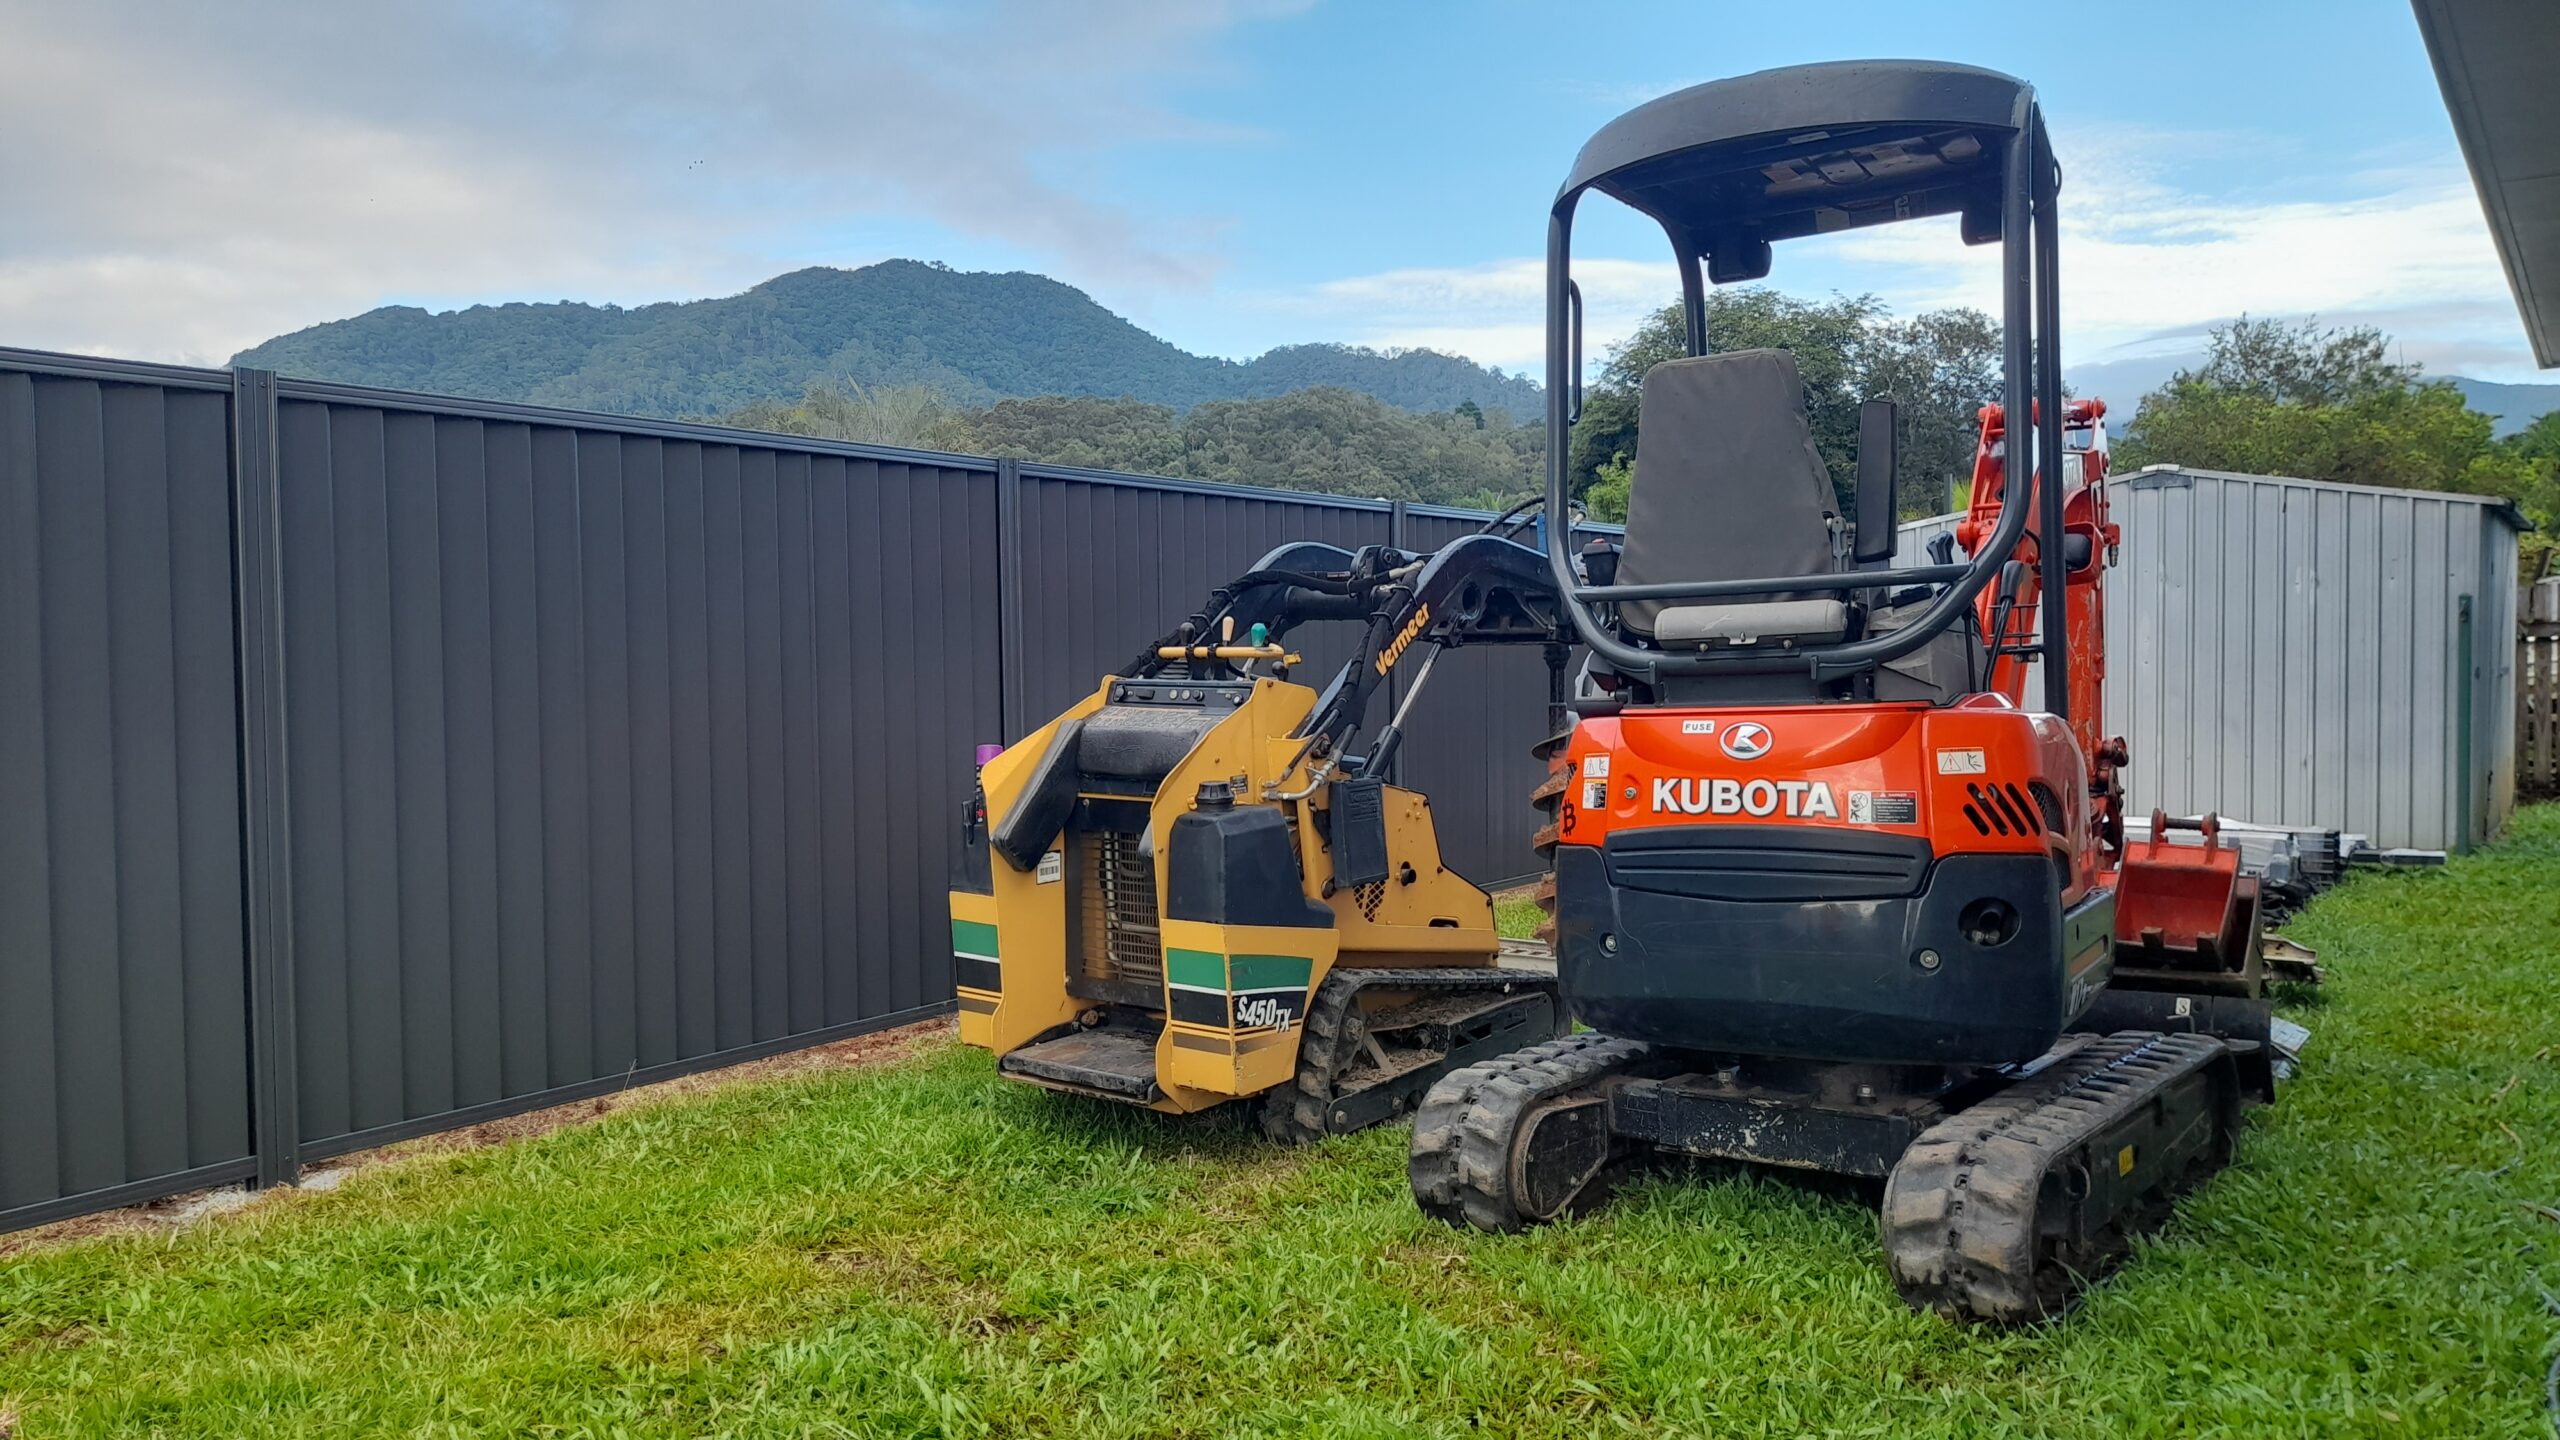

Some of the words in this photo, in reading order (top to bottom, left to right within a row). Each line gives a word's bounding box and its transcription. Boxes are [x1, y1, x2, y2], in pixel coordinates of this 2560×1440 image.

[1375, 602, 1430, 677] Vermeer
[1685, 722, 1712, 732] FUSE
[1652, 778, 1839, 819] KUBOTA
